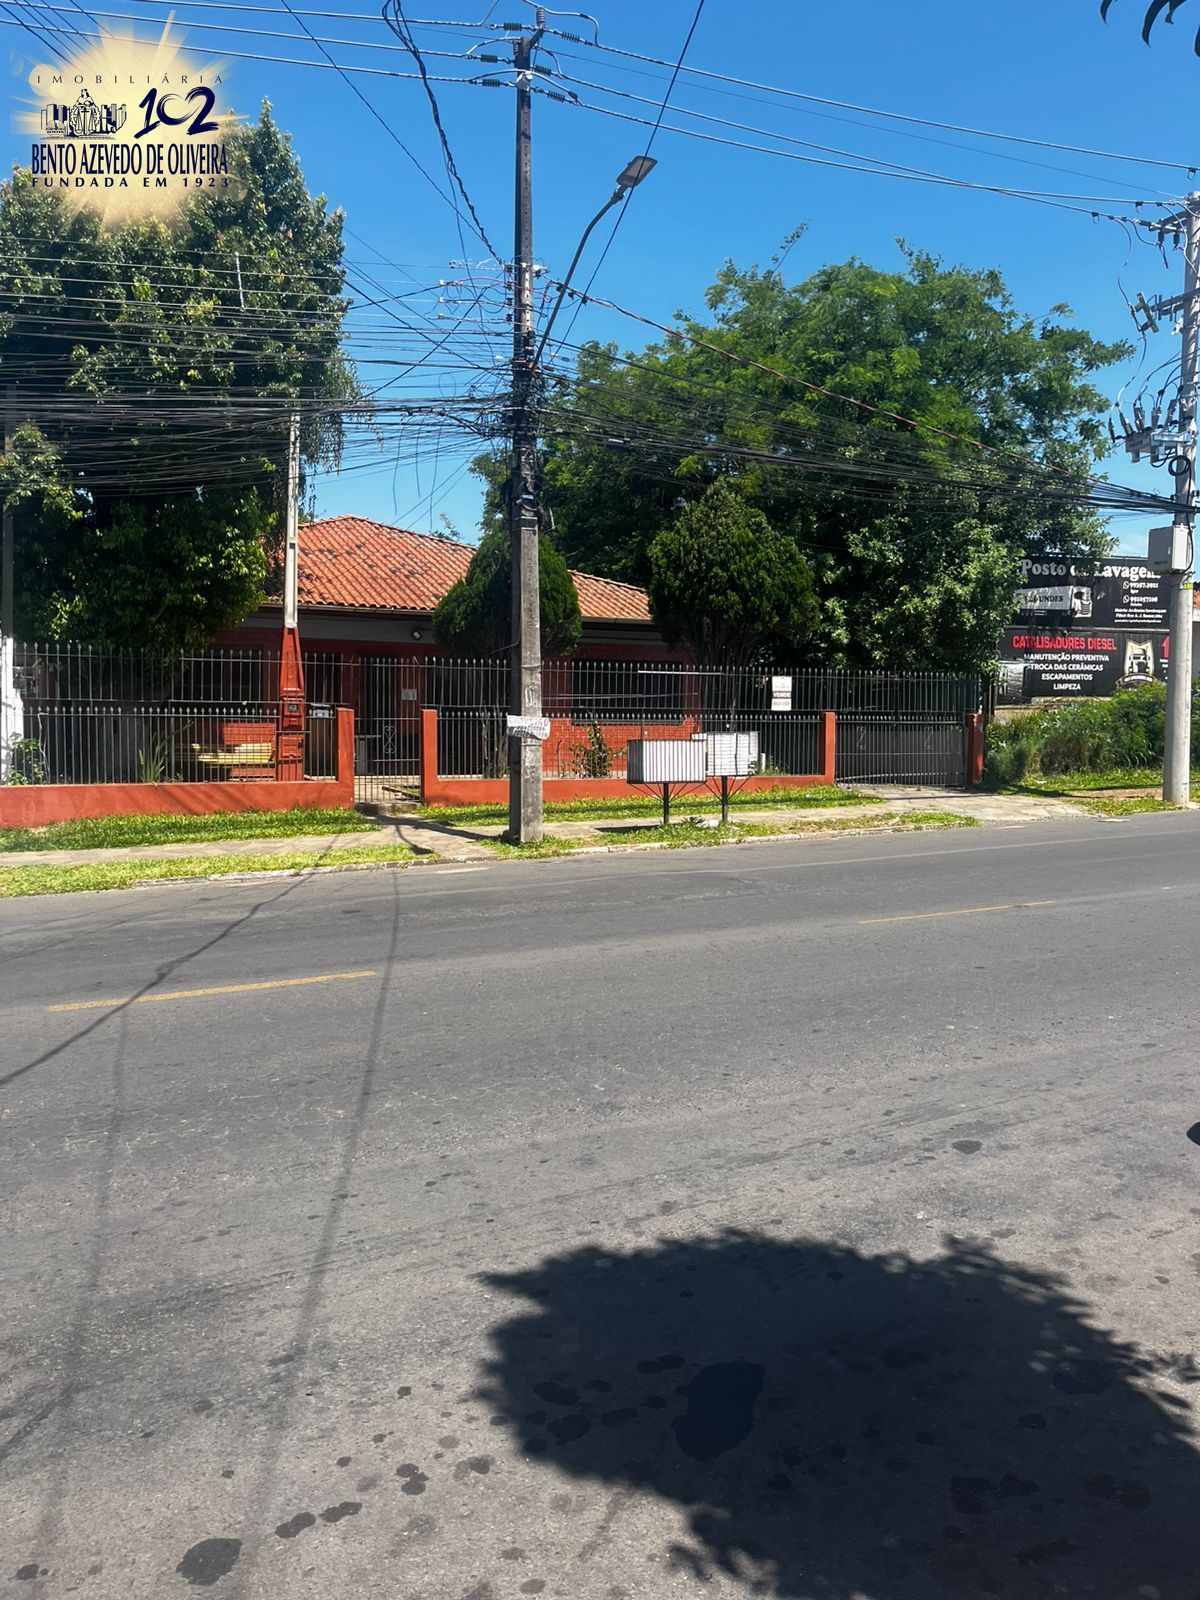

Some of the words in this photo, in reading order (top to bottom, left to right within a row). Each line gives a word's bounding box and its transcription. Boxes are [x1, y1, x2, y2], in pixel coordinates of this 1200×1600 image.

[1020, 559, 1067, 576] Posto
[1087, 637, 1117, 650] DIESEL
[1024, 652, 1070, 662] MANUTENÇÃO
[1068, 662, 1104, 671] CERÂMICAS
